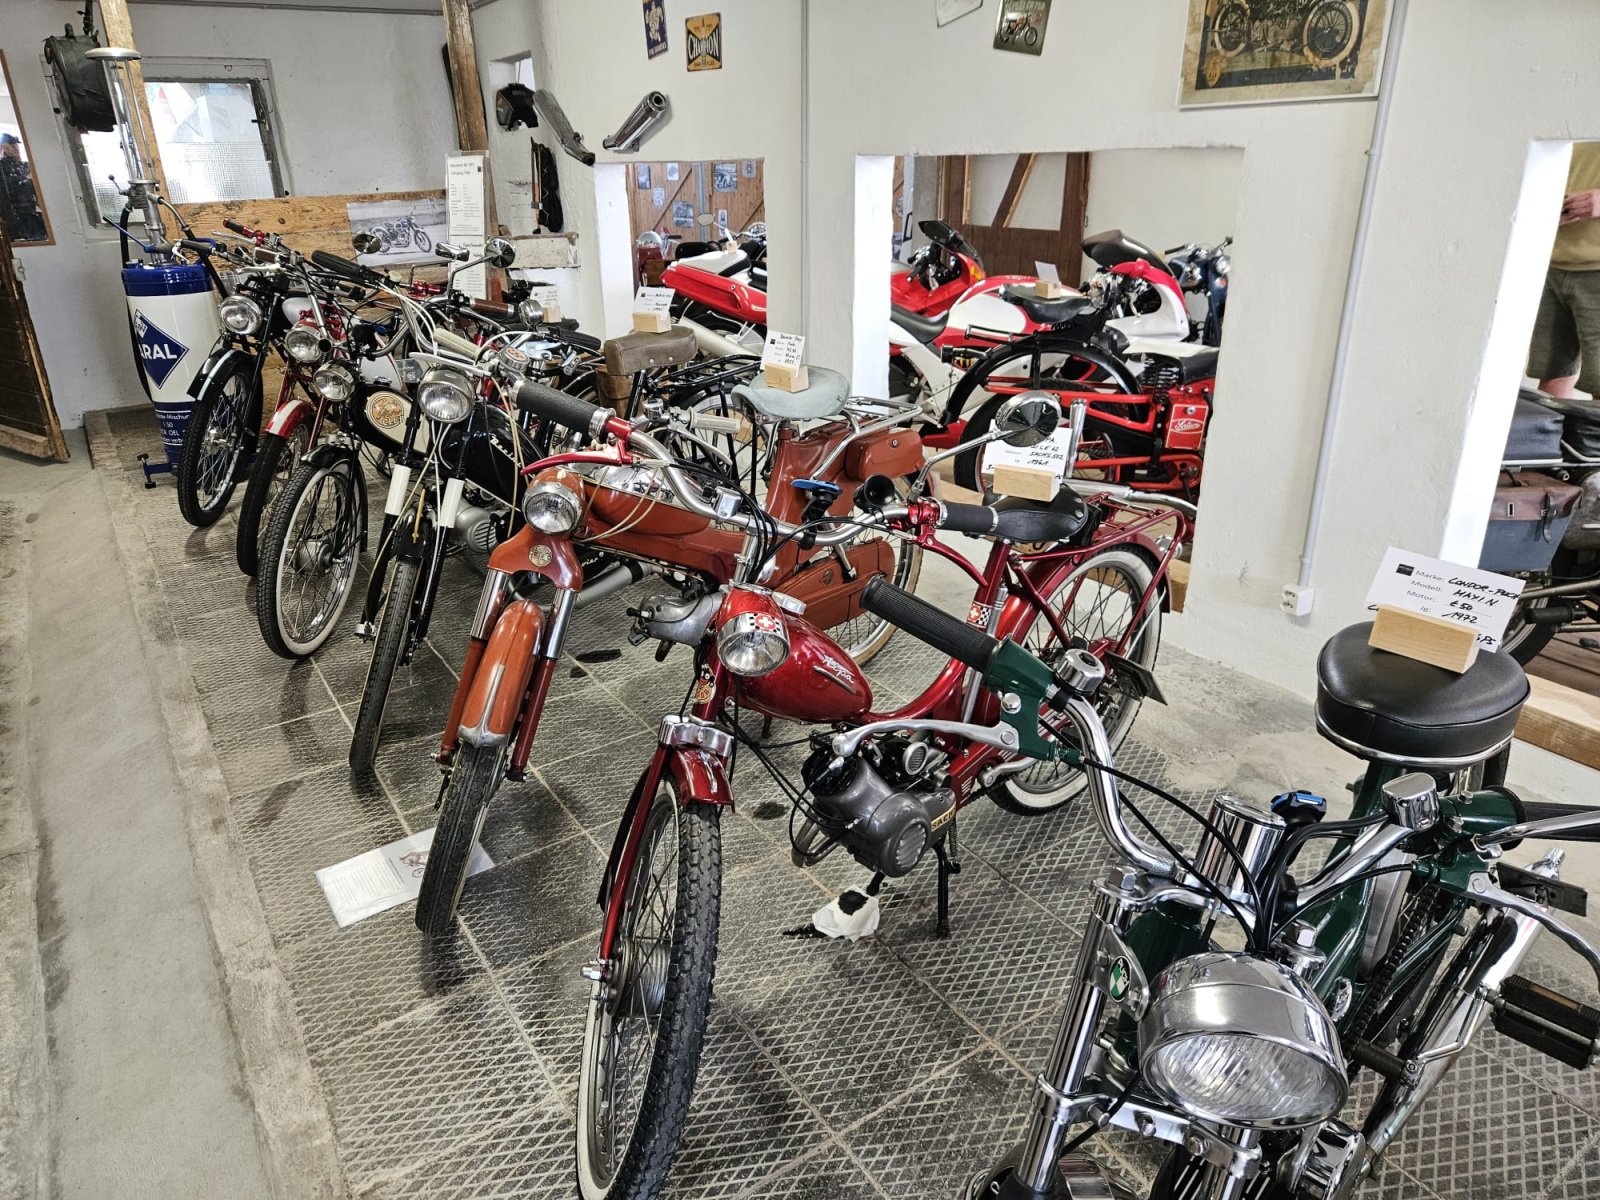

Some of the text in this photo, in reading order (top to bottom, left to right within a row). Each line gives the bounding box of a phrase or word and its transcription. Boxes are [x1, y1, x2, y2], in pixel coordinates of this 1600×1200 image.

[1415, 570, 1446, 583] Marke:
[1411, 580, 1443, 593] Modell:
[1406, 590, 1436, 603] Motor:
[1442, 612, 1478, 625] 1972
[1117, 957, 1130, 987] PUCH
